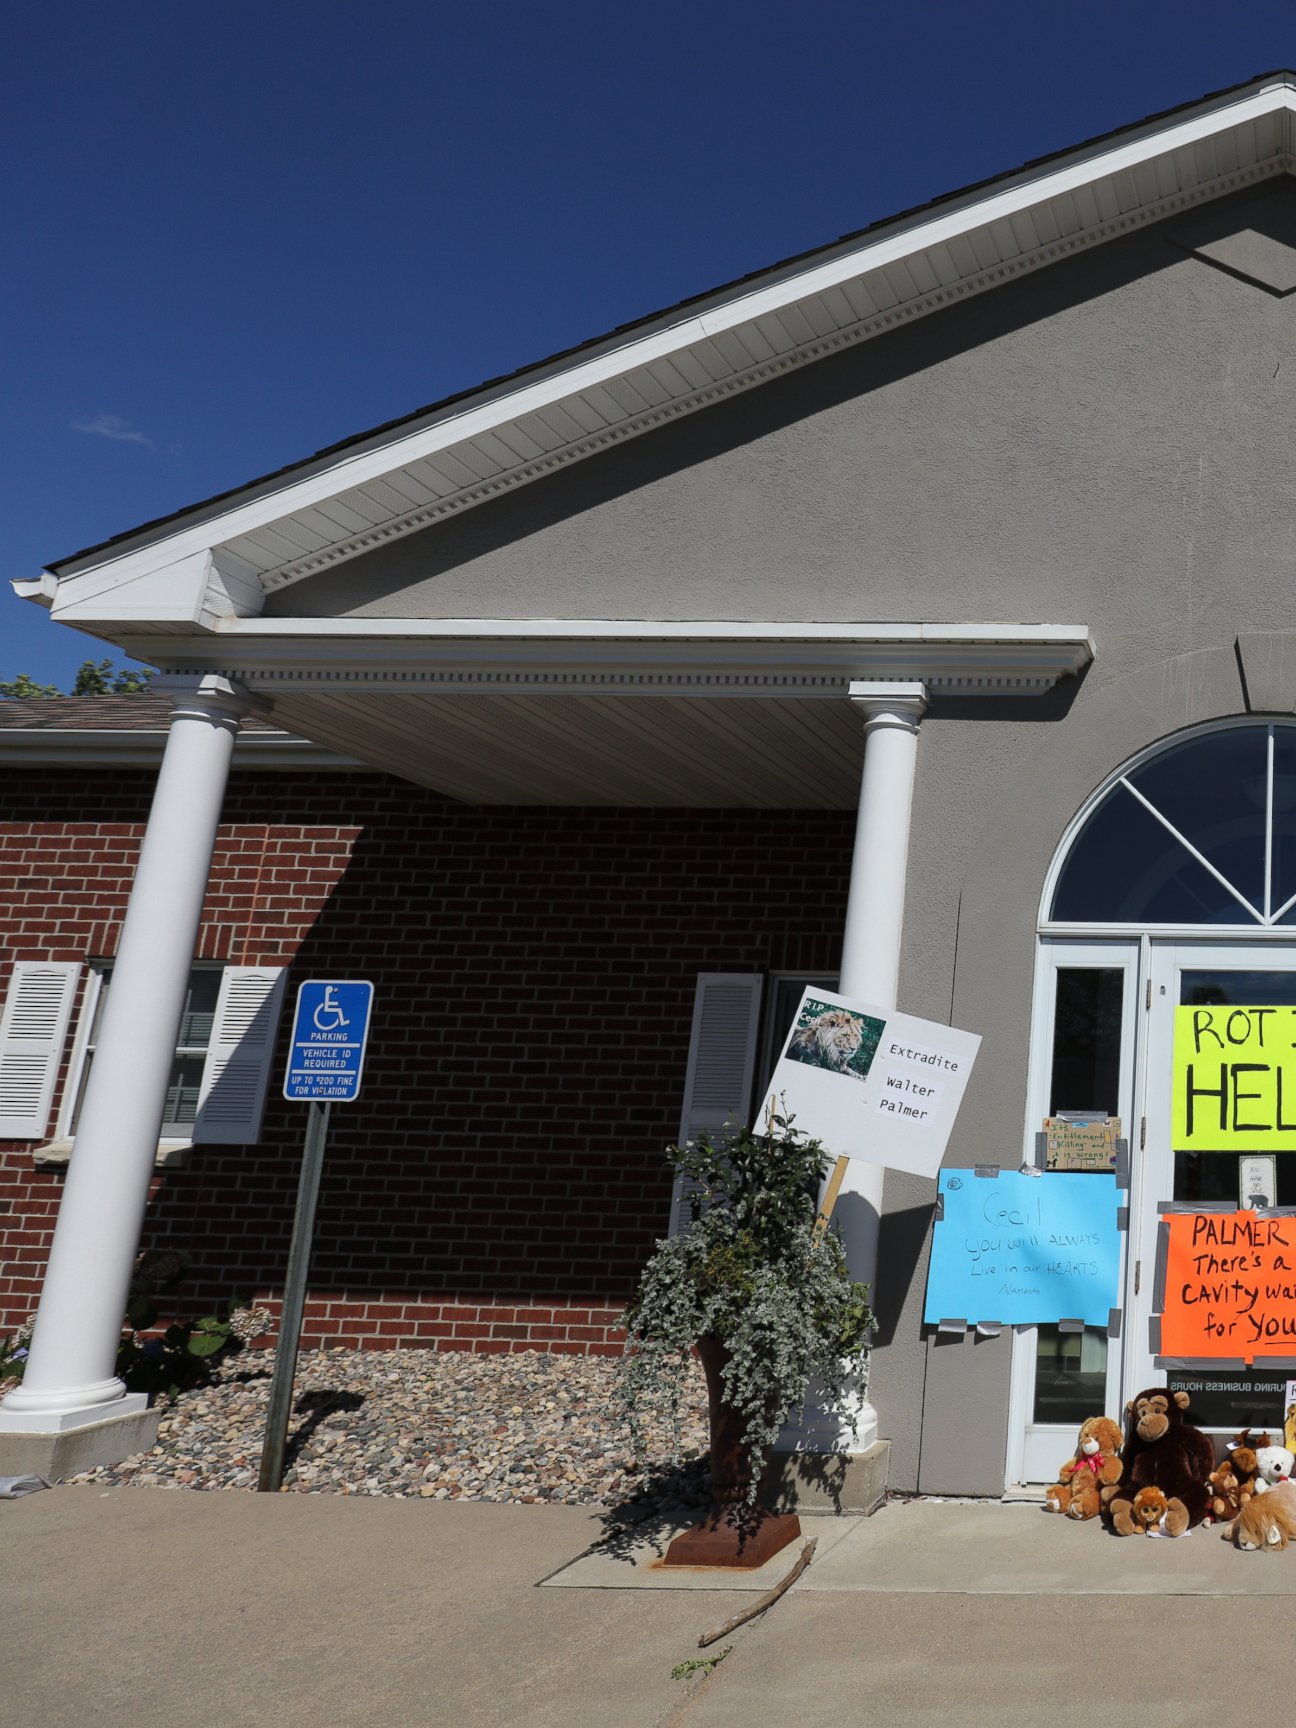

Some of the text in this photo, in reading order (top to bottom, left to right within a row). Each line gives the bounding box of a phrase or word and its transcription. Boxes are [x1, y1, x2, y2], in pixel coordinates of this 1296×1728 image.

[800, 1012, 821, 1024] Cecil
[310, 1032, 348, 1041] PARKING
[1194, 1009, 1276, 1054] ROT
[303, 1050, 337, 1058] VEHICLE
[890, 1044, 958, 1072] Extradite
[304, 1060, 346, 1068] REQUIRED
[316, 1077, 334, 1085] $200
[337, 1077, 353, 1086] FINE
[886, 1076, 935, 1096] Walter
[295, 1087, 347, 1095] FOR VILATION
[880, 1099, 928, 1120] Palmer
[983, 1192, 1040, 1227] Cecil
[1192, 1215, 1289, 1247] PALMER
[1008, 1236, 1039, 1249] will
[1049, 1234, 1100, 1247] ALWAYS
[971, 1265, 996, 1276] Live
[1047, 1261, 1098, 1276] HEARTS
[1193, 1252, 1262, 1275] There's
[1273, 1257, 1291, 1270] a
[1204, 1313, 1237, 1338] for
